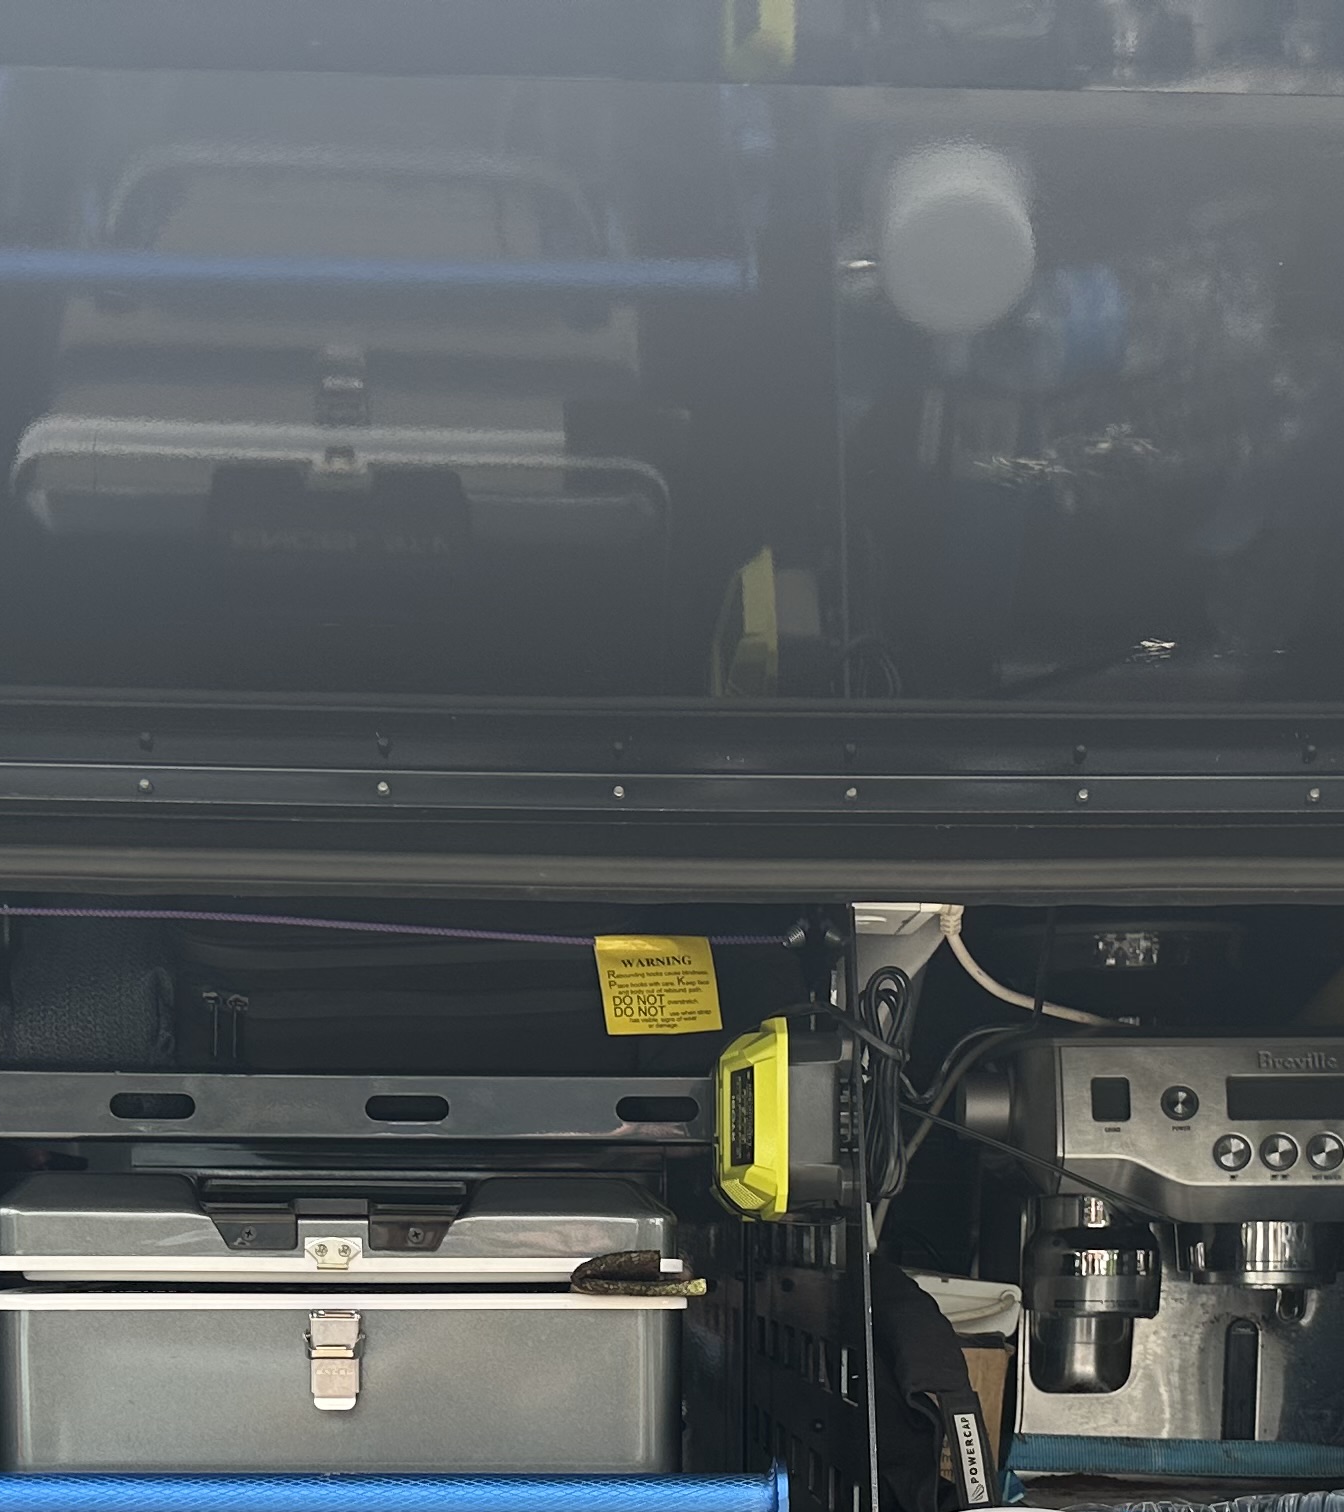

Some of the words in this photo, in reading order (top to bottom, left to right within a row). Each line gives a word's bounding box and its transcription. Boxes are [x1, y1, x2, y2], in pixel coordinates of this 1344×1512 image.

[621, 955, 692, 968] WARNING
[613, 995, 633, 1006] DO
[637, 994, 665, 1006] NOT
[614, 1006, 634, 1018] DO
[638, 1005, 666, 1017] NOT
[1256, 1050, 1338, 1070] Breville
[960, 1416, 980, 1484] POWERCAP
